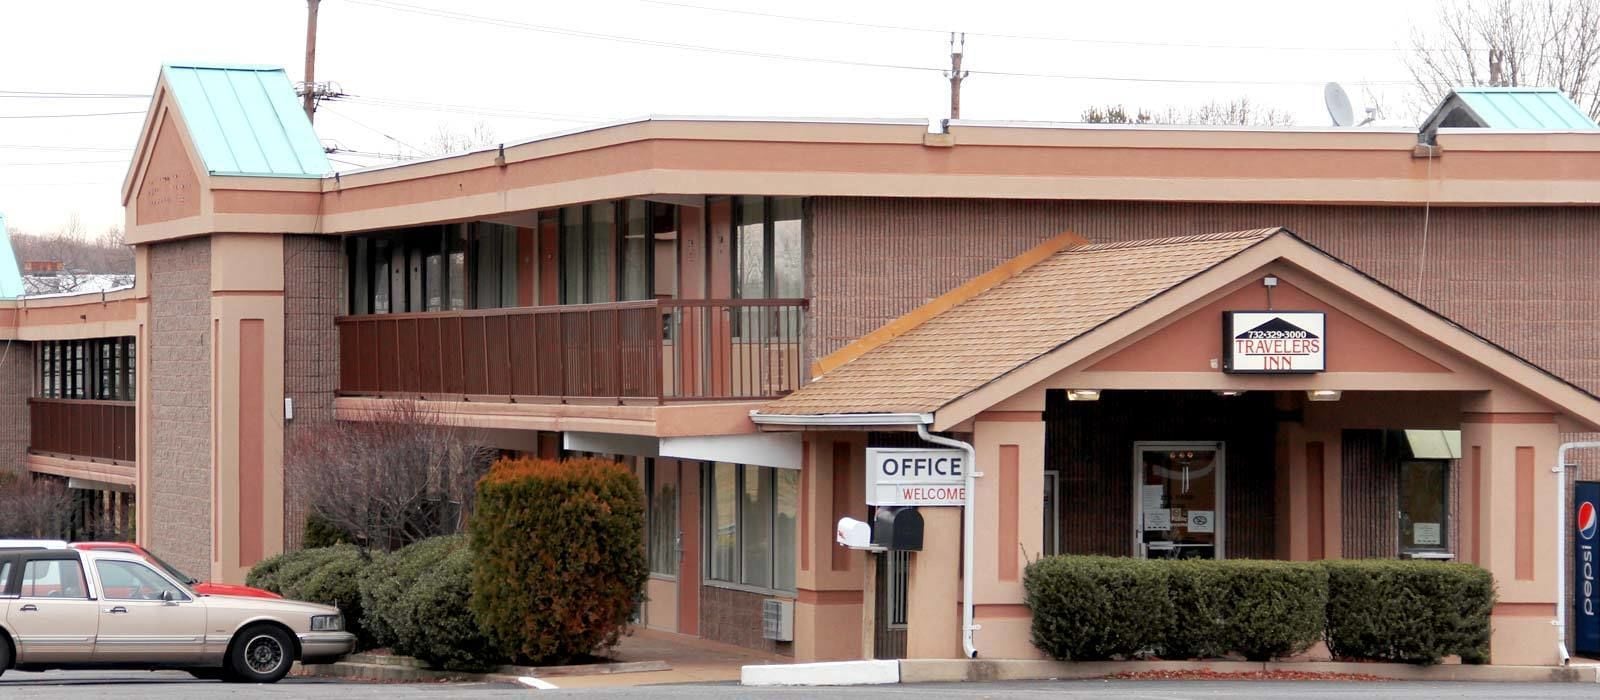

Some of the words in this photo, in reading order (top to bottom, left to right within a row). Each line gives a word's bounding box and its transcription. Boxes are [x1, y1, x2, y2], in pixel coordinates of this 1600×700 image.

[1235, 340, 1320, 353] TRAVELERS
[1264, 356, 1292, 370] INN
[882, 458, 962, 476] OFFICE
[903, 488, 966, 500] WELCOME
[1582, 545, 1594, 616] pepsi
